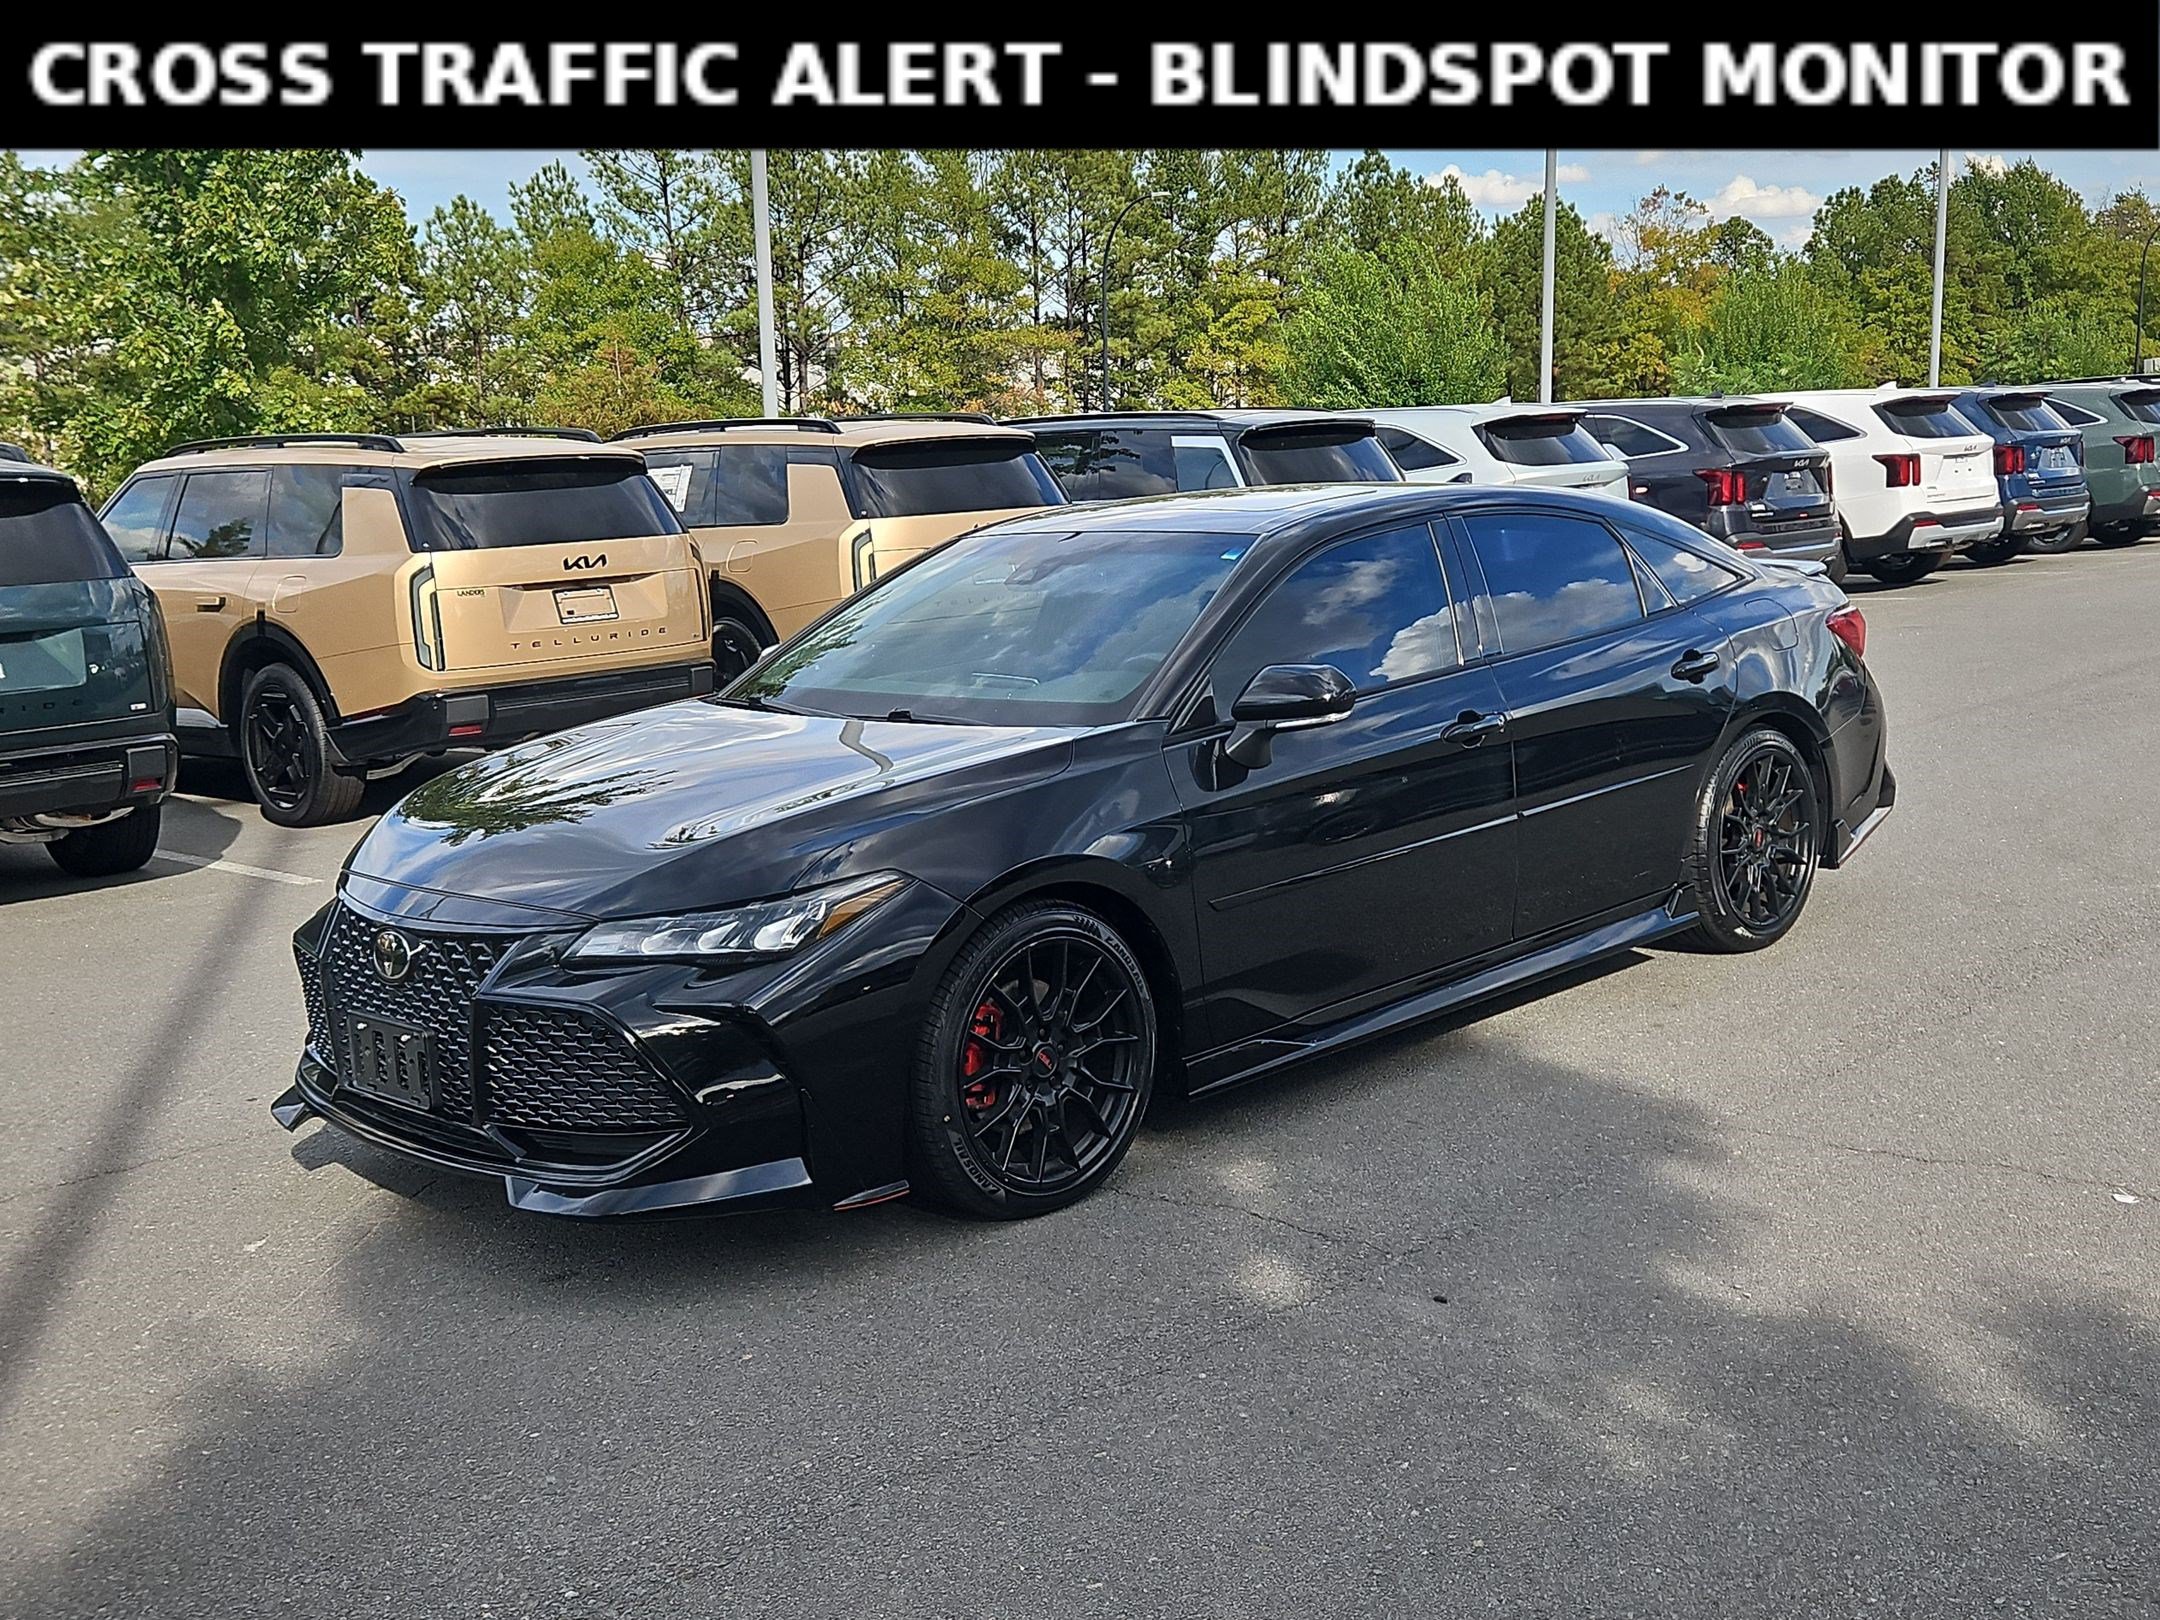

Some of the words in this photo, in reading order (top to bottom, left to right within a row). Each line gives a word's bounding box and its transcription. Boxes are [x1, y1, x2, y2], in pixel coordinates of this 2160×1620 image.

[1793, 458, 1810, 467] KIA
[563, 553, 608, 570] KIA
[510, 626, 668, 650] TELLURIDE
